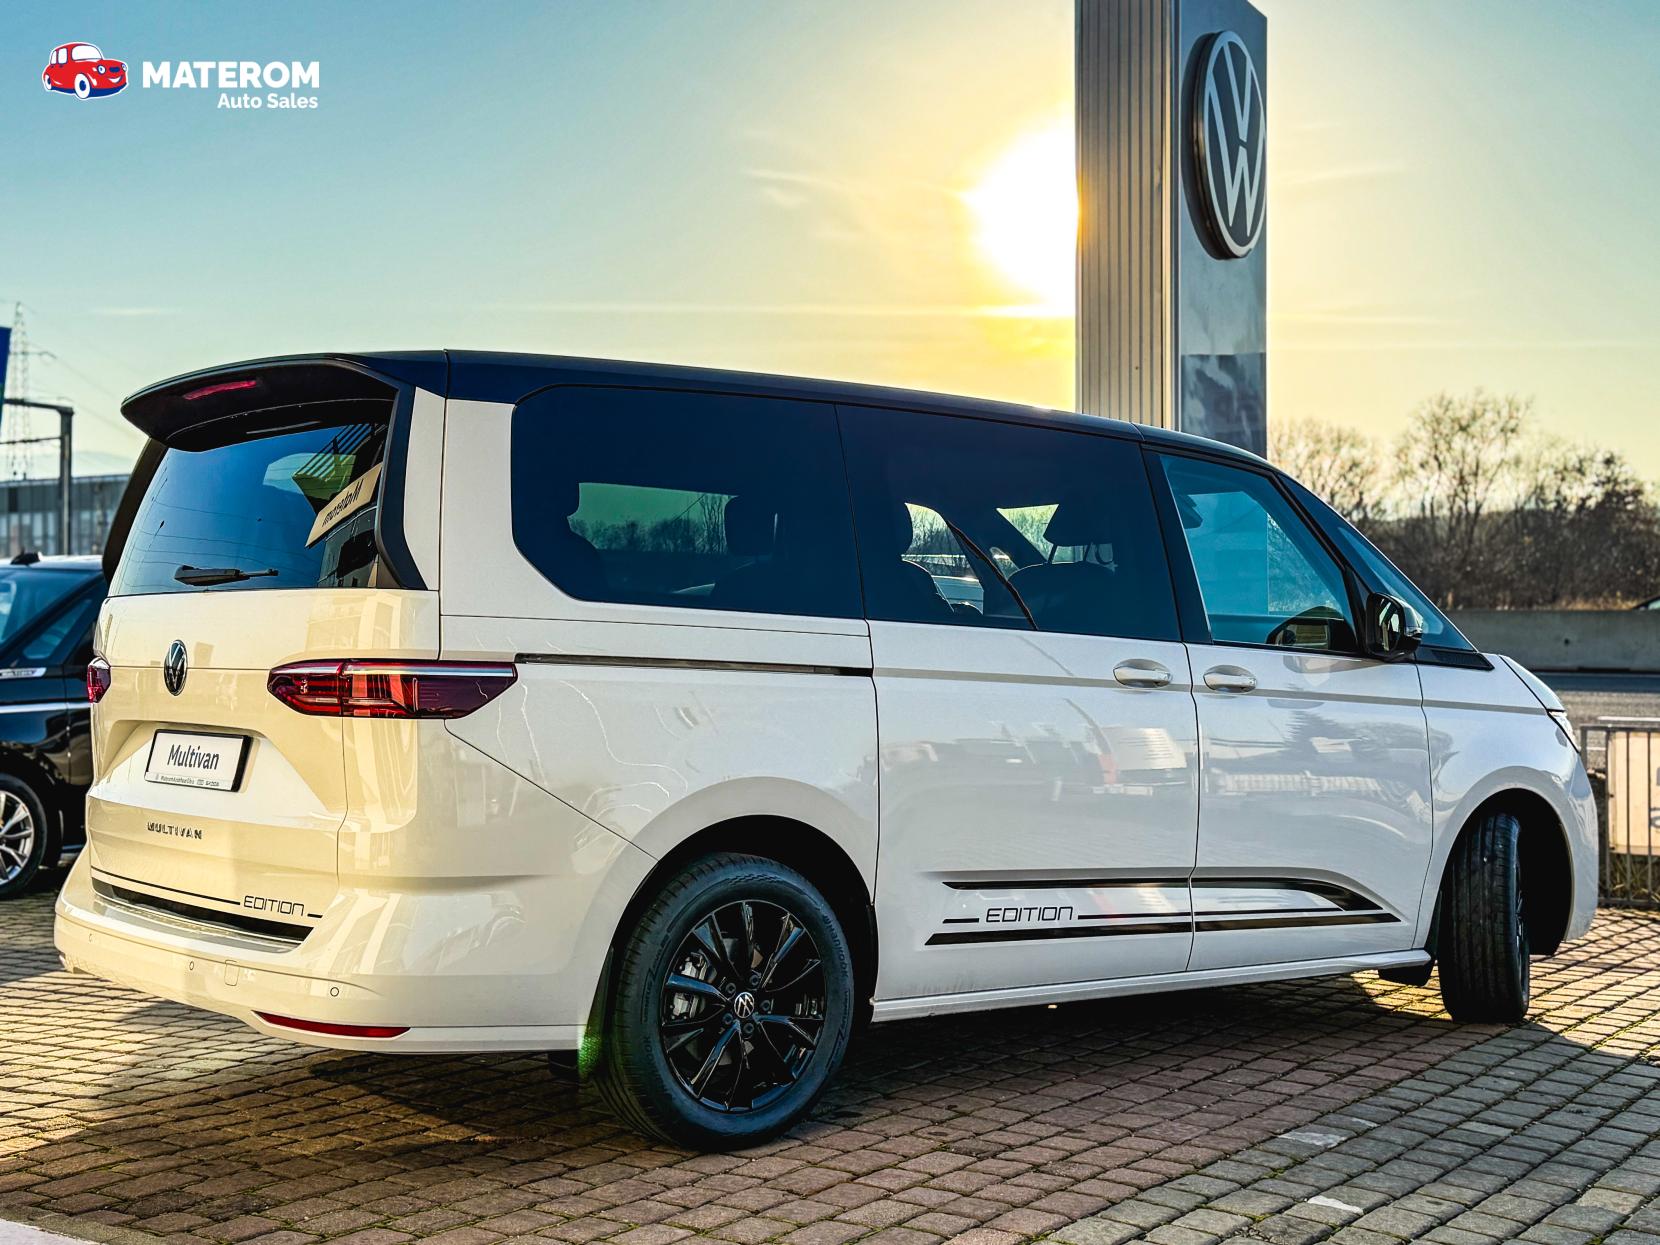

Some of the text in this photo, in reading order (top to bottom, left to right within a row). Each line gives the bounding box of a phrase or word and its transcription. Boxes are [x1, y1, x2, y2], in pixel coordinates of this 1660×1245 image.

[167, 744, 220, 770] Multivan
[147, 822, 203, 840] MULTIVAN
[243, 895, 305, 917] EDITION
[985, 906, 1074, 923] EDITION
